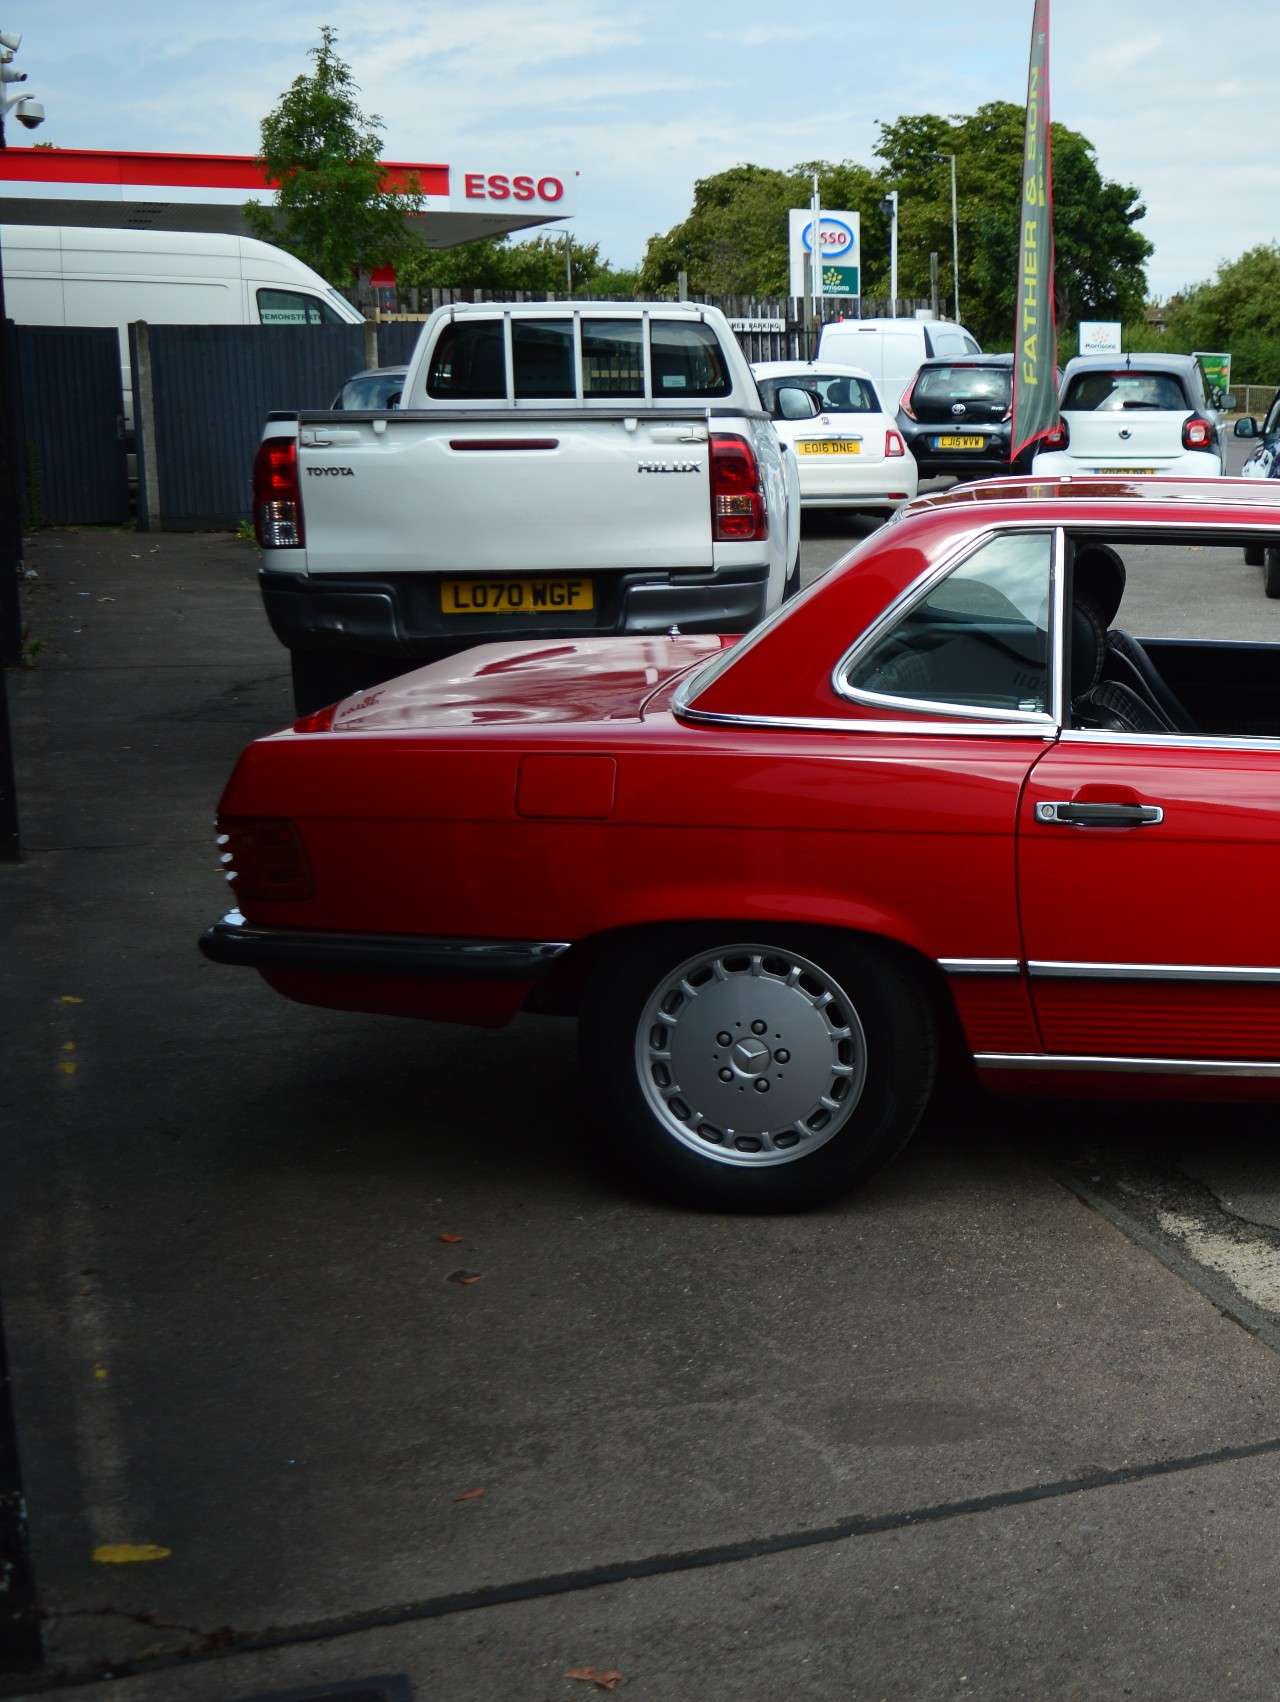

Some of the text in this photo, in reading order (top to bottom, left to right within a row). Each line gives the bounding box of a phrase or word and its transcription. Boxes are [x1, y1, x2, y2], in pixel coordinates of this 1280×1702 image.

[464, 173, 564, 202] ESSO
[1022, 66, 1039, 385] FATHER & SON
[804, 443, 854, 453] EO16 DNE
[306, 466, 354, 476] TOYOTA
[638, 460, 702, 473] HILUX
[453, 582, 583, 609] LO70 WGF
